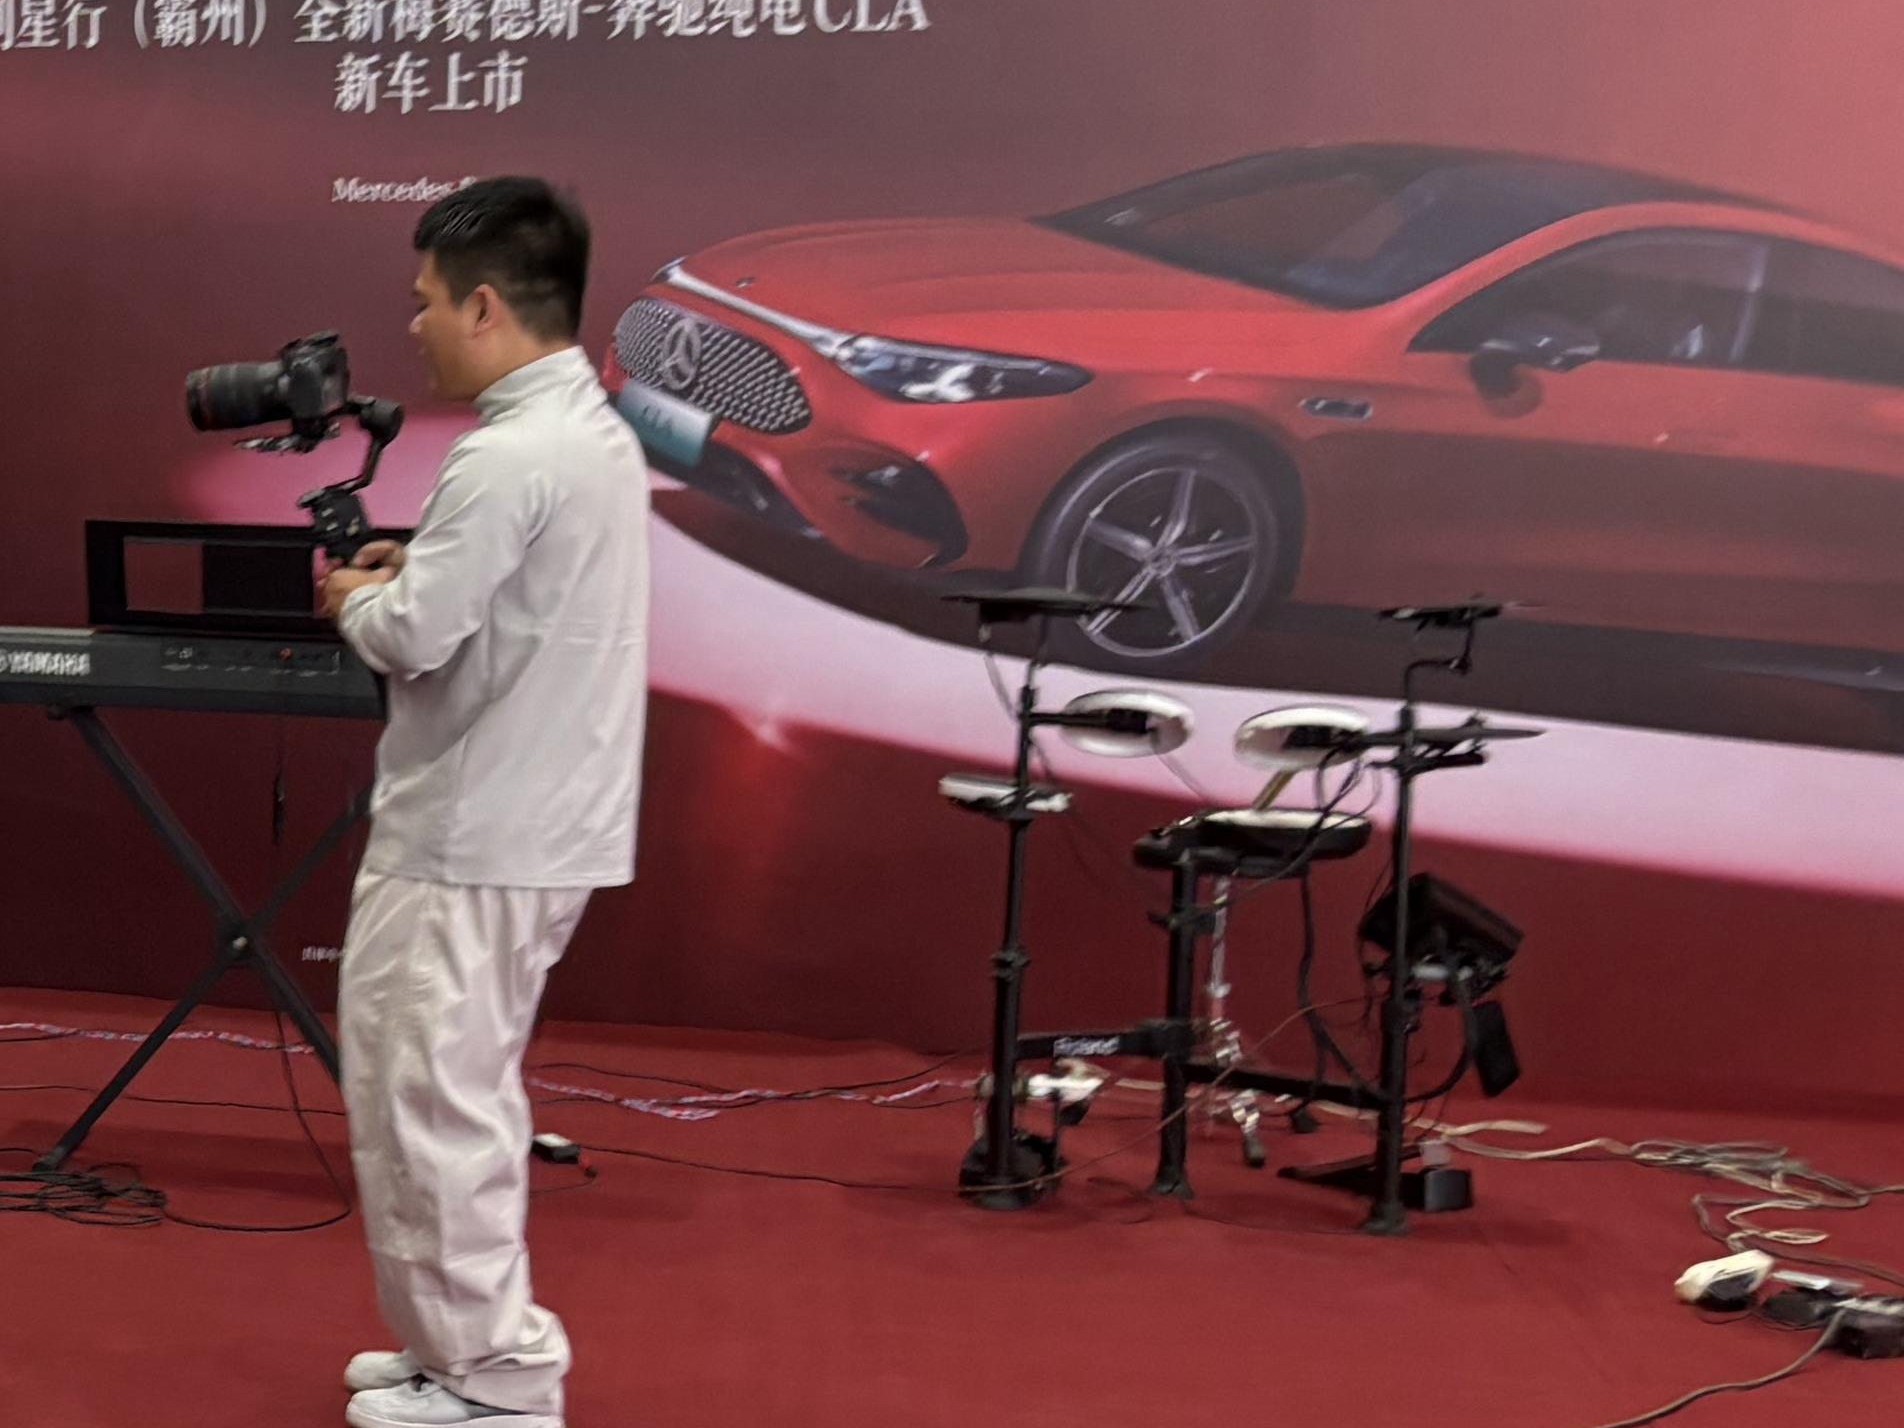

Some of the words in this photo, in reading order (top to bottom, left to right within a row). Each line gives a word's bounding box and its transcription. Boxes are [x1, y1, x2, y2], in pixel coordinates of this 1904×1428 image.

[334, 49, 528, 114] 新车上市
[7, 650, 91, 676] YAMAHA
